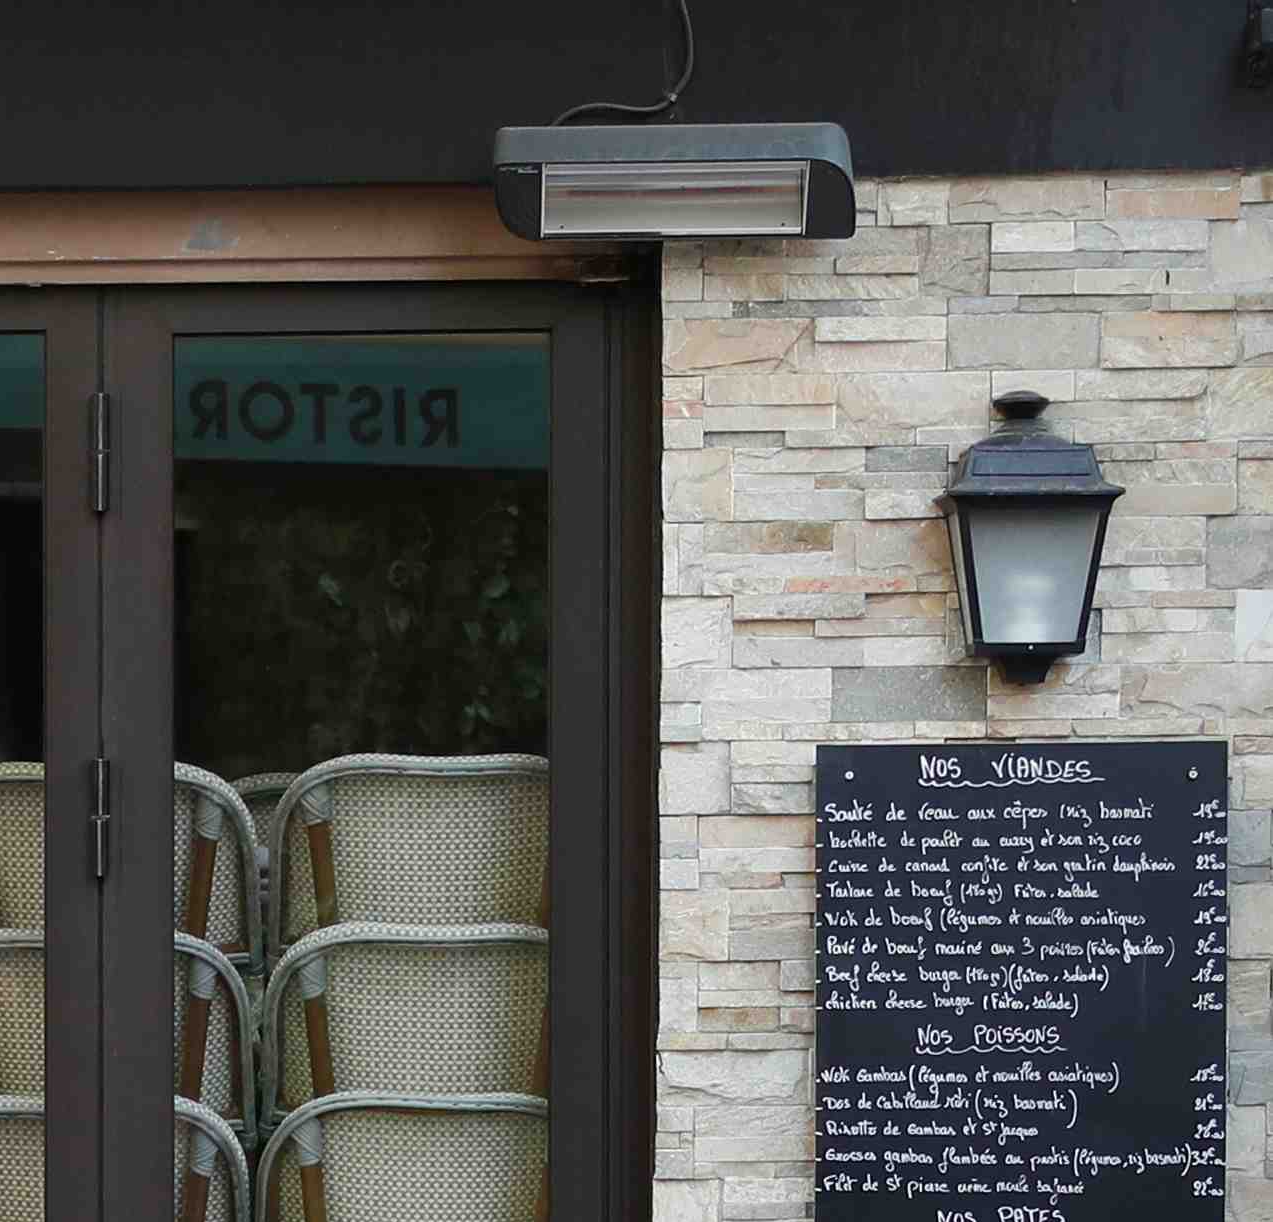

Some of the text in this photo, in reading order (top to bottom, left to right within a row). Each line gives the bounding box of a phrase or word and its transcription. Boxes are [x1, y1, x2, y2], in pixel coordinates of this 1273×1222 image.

[921, 753, 1091, 779] NOS VIANDES
[825, 799, 872, 822] Sauté
[886, 802, 906, 821] de
[918, 803, 959, 820] veau
[968, 809, 995, 819] aux
[1100, 798, 1154, 818] basmati
[901, 831, 915, 846] de
[922, 830, 963, 855] poulet
[972, 837, 990, 846] au
[1041, 829, 1054, 846] et
[1058, 834, 1083, 846] son
[1088, 833, 1110, 853] riz
[1112, 835, 1141, 846] coco
[879, 857, 896, 872] de
[906, 858, 950, 872] canard
[1018, 856, 1030, 871] et
[1033, 859, 1058, 871] son
[1064, 854, 1106, 882] gratin
[1113, 852, 1175, 881] dauphinois
[885, 880, 901, 897] de
[1057, 882, 1099, 898] salade
[825, 910, 858, 926] Wok
[865, 908, 883, 926] de
[1009, 908, 1021, 924] et
[1081, 909, 1145, 934] asiatiques
[827, 936, 855, 954] Pavé
[862, 937, 878, 954] de
[991, 944, 1014, 955] aux
[1022, 937, 1034, 955] 3
[826, 965, 859, 991] Beef
[821, 1066, 850, 1083] Wok
[857, 1066, 906, 1082] Gambas
[976, 1065, 989, 1082] et
[993, 1061, 1041, 1082] nouilles
[822, 1097, 850, 1109] Dos
[858, 1092, 871, 1109] de
[826, 1120, 877, 1135] Risotto
[884, 1121, 901, 1135] de
[963, 1117, 977, 1135] et
[982, 1121, 997, 1135] St
[884, 1148, 933, 1172] gambas
[1005, 1155, 1024, 1164] au
[824, 1173, 857, 1191] Filet
[863, 1174, 878, 1191] de
[886, 1174, 902, 1191] St
